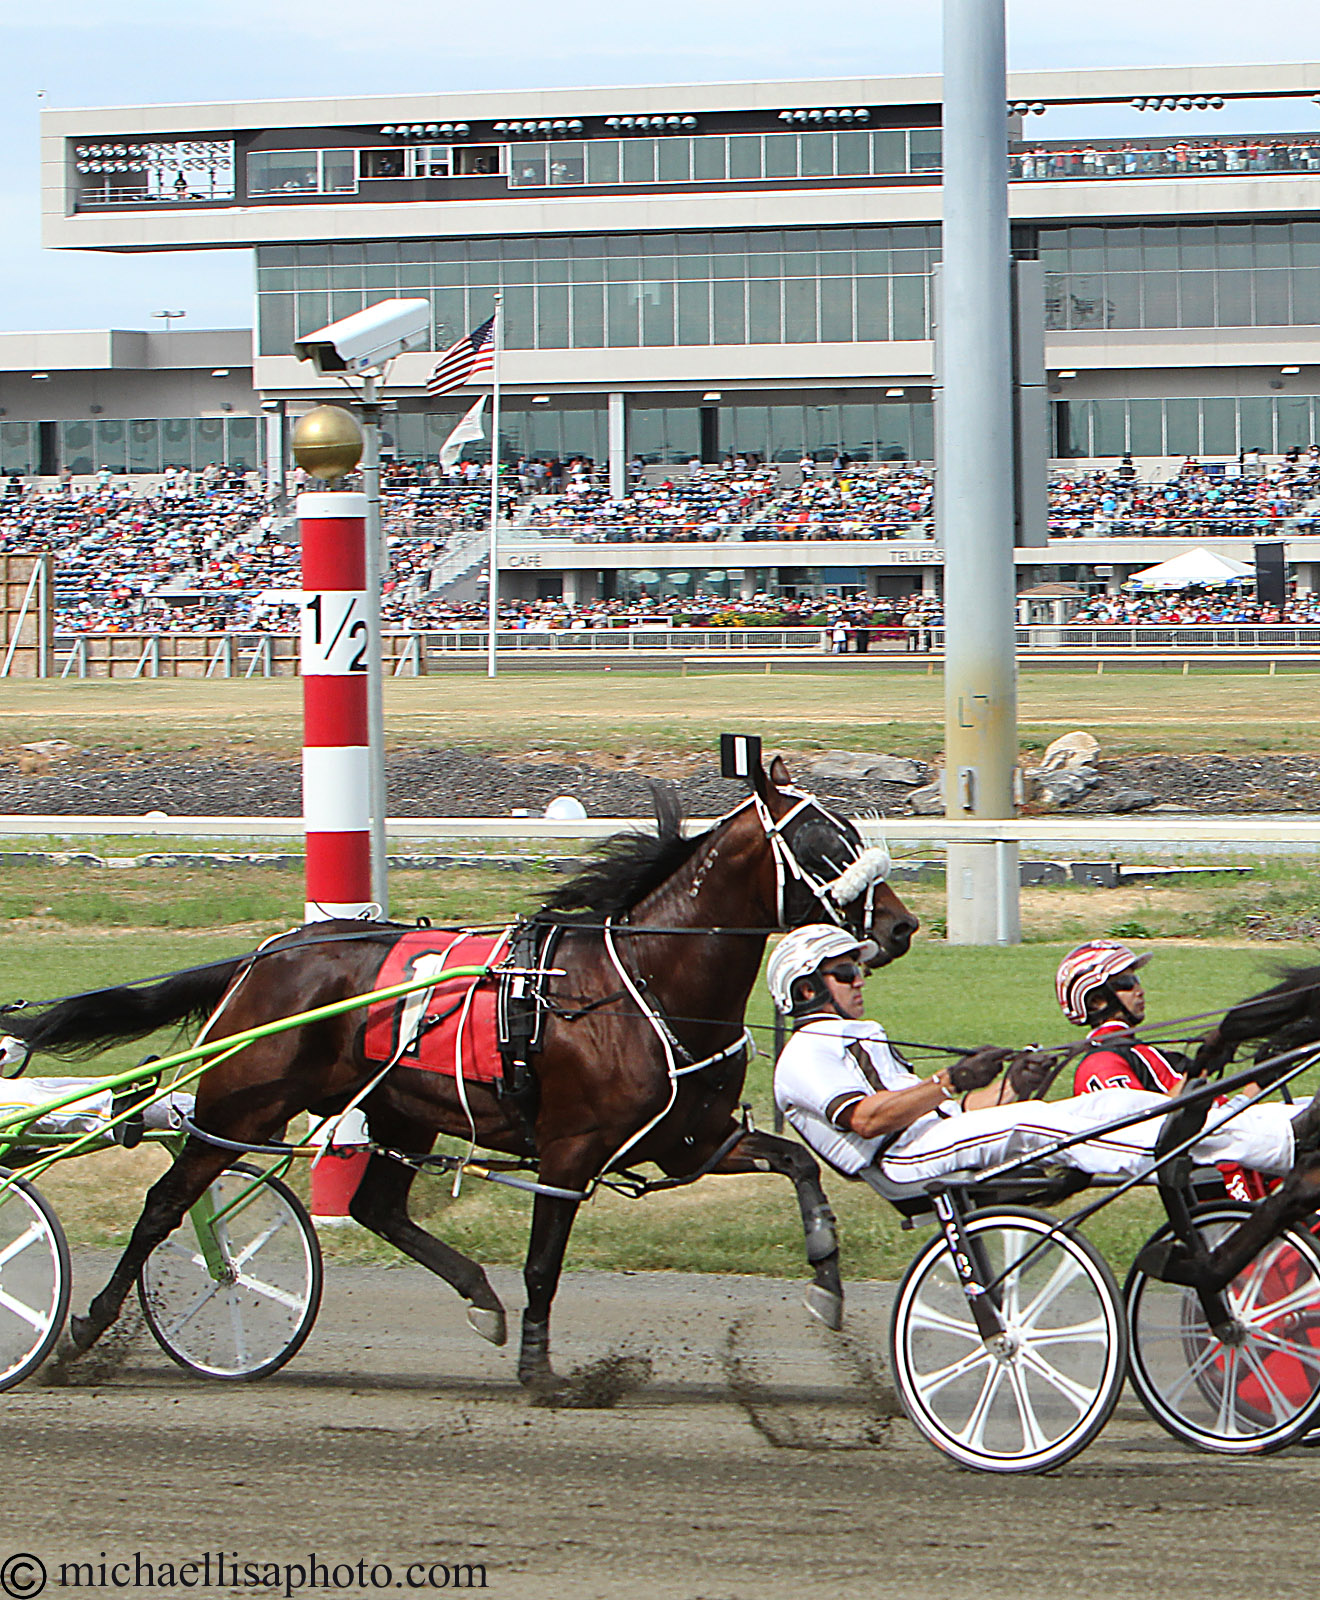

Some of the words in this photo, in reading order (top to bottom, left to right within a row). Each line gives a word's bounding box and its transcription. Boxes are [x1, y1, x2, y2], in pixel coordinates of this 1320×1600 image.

[508, 554, 542, 567] CAFÉ
[889, 549, 945, 562] TELLERS
[307, 594, 367, 672] 1/2
[734, 736, 748, 776] 1
[396, 951, 443, 1057] 1
